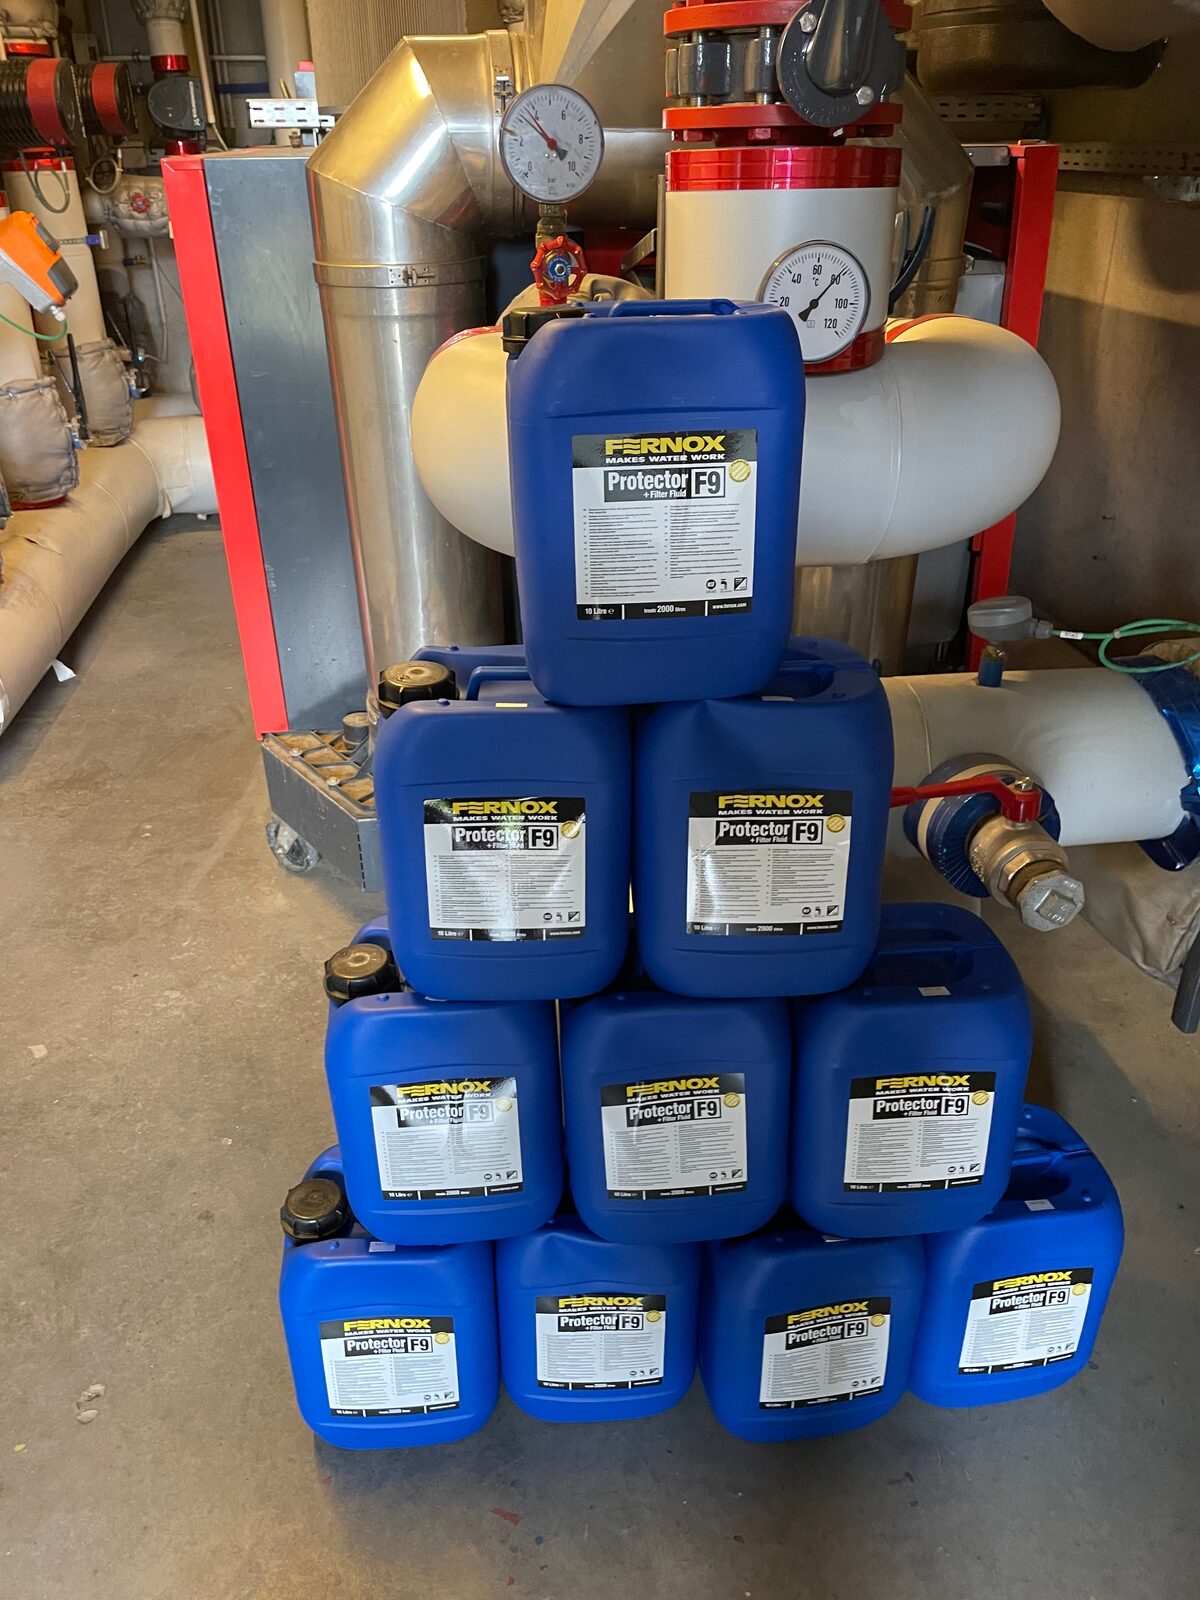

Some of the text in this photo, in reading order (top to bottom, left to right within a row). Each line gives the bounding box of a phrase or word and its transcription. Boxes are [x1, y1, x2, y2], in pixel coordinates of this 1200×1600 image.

[561, 110, 565, 120] 6
[520, 136, 523, 146] 2
[579, 134, 583, 144] 8
[528, 161, 532, 171] 0
[568, 161, 576, 171] 10
[813, 265, 822, 275] 60
[792, 273, 801, 284] 40
[780, 296, 789, 307] 20
[835, 298, 848, 309] 100
[824, 318, 837, 329] 120
[605, 435, 726, 455] FERNOX
[608, 471, 721, 494] Protector F9
[650, 490, 668, 498] Filter
[669, 489, 687, 498] Fluid
[657, 605, 674, 613] 2000
[452, 801, 558, 814] FERNOX
[718, 794, 824, 809] FERNOX
[455, 828, 554, 847] Protector F9
[719, 822, 819, 841] Protector F9
[626, 1077, 719, 1097] FERNOX
[875, 1075, 971, 1090] FERNOX
[397, 1081, 491, 1098] FERNOX
[627, 1095, 658, 1103] MAKES
[876, 1098, 965, 1113] Protector F9
[400, 1106, 464, 1121] Protector
[469, 1104, 490, 1121] F9
[629, 1101, 717, 1120] Protector F9
[992, 1271, 1072, 1291] FERNOX
[559, 1297, 644, 1308] FERNOX
[992, 1293, 1045, 1309] Protector
[1048, 1291, 1065, 1304] F9
[787, 1301, 869, 1325] FERNOX
[344, 1318, 430, 1332] FERNOX
[560, 1315, 640, 1328] Protector F9
[788, 1325, 843, 1344] Protector
[847, 1322, 864, 1336] F9
[347, 1339, 429, 1352] Protector F9
